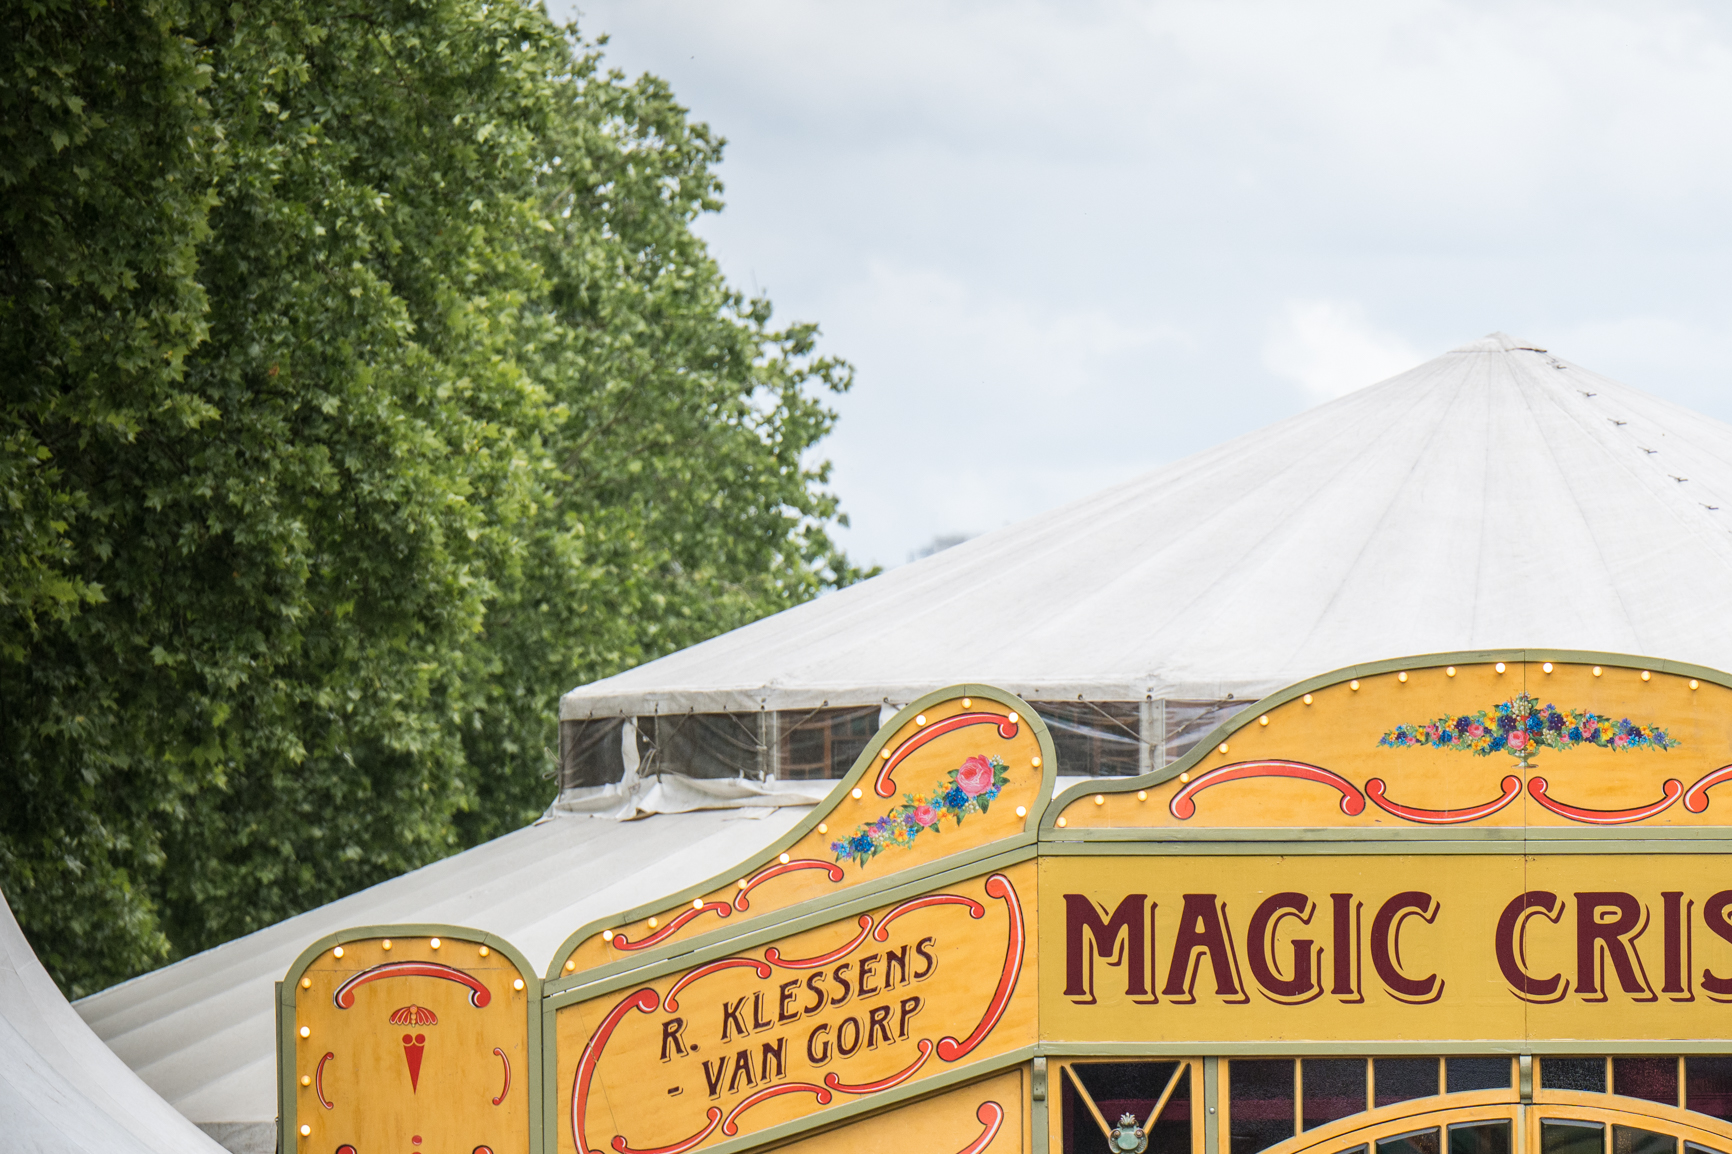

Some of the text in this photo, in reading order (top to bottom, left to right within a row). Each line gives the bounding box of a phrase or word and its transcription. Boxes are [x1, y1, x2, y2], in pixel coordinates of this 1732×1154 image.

[659, 936, 938, 1063] R. KLESSENS
[1063, 890, 1446, 1005] MAGIC
[701, 1036, 788, 1100] VAN
[806, 996, 926, 1068] GORP
